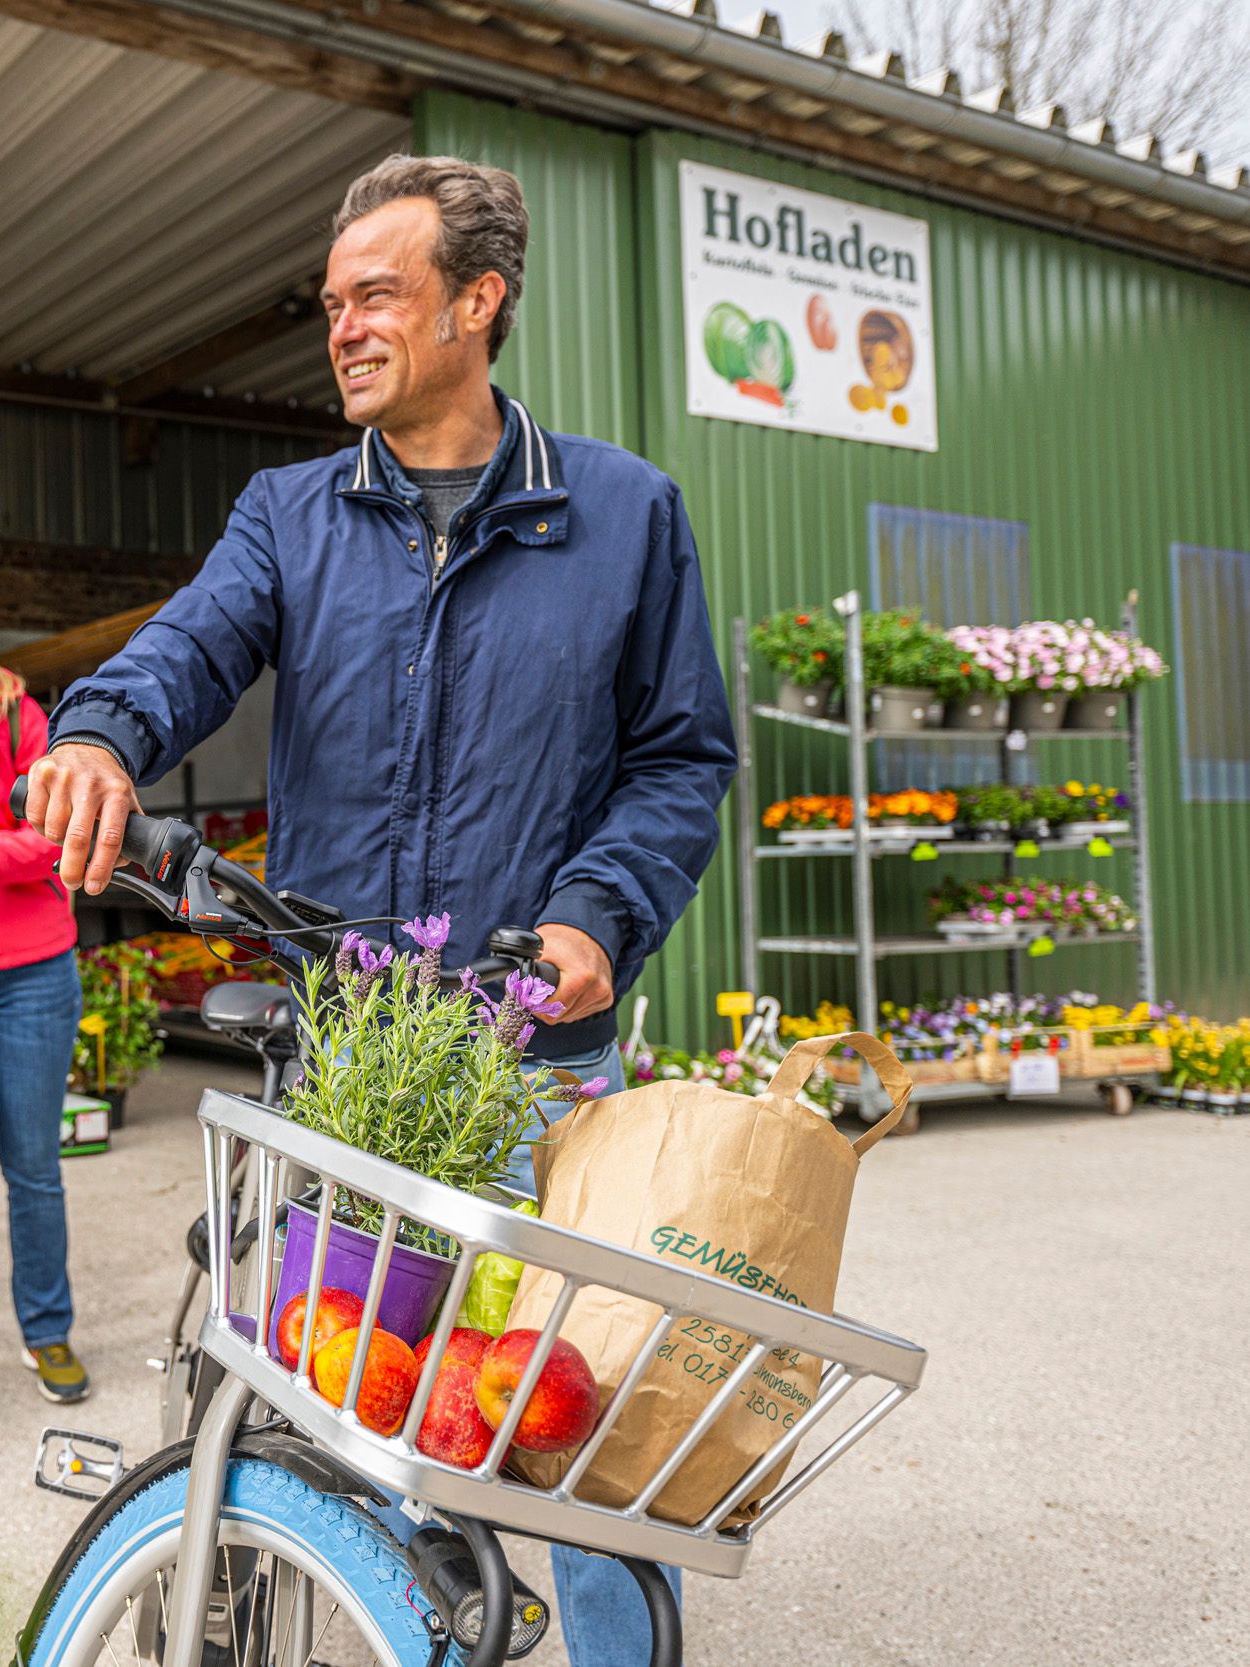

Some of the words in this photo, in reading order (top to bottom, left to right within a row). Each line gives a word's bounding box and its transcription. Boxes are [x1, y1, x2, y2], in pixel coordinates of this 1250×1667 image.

[703, 187, 917, 283] Hofladen
[657, 1343, 680, 1362] el.
[680, 1318, 751, 1364] 2581
